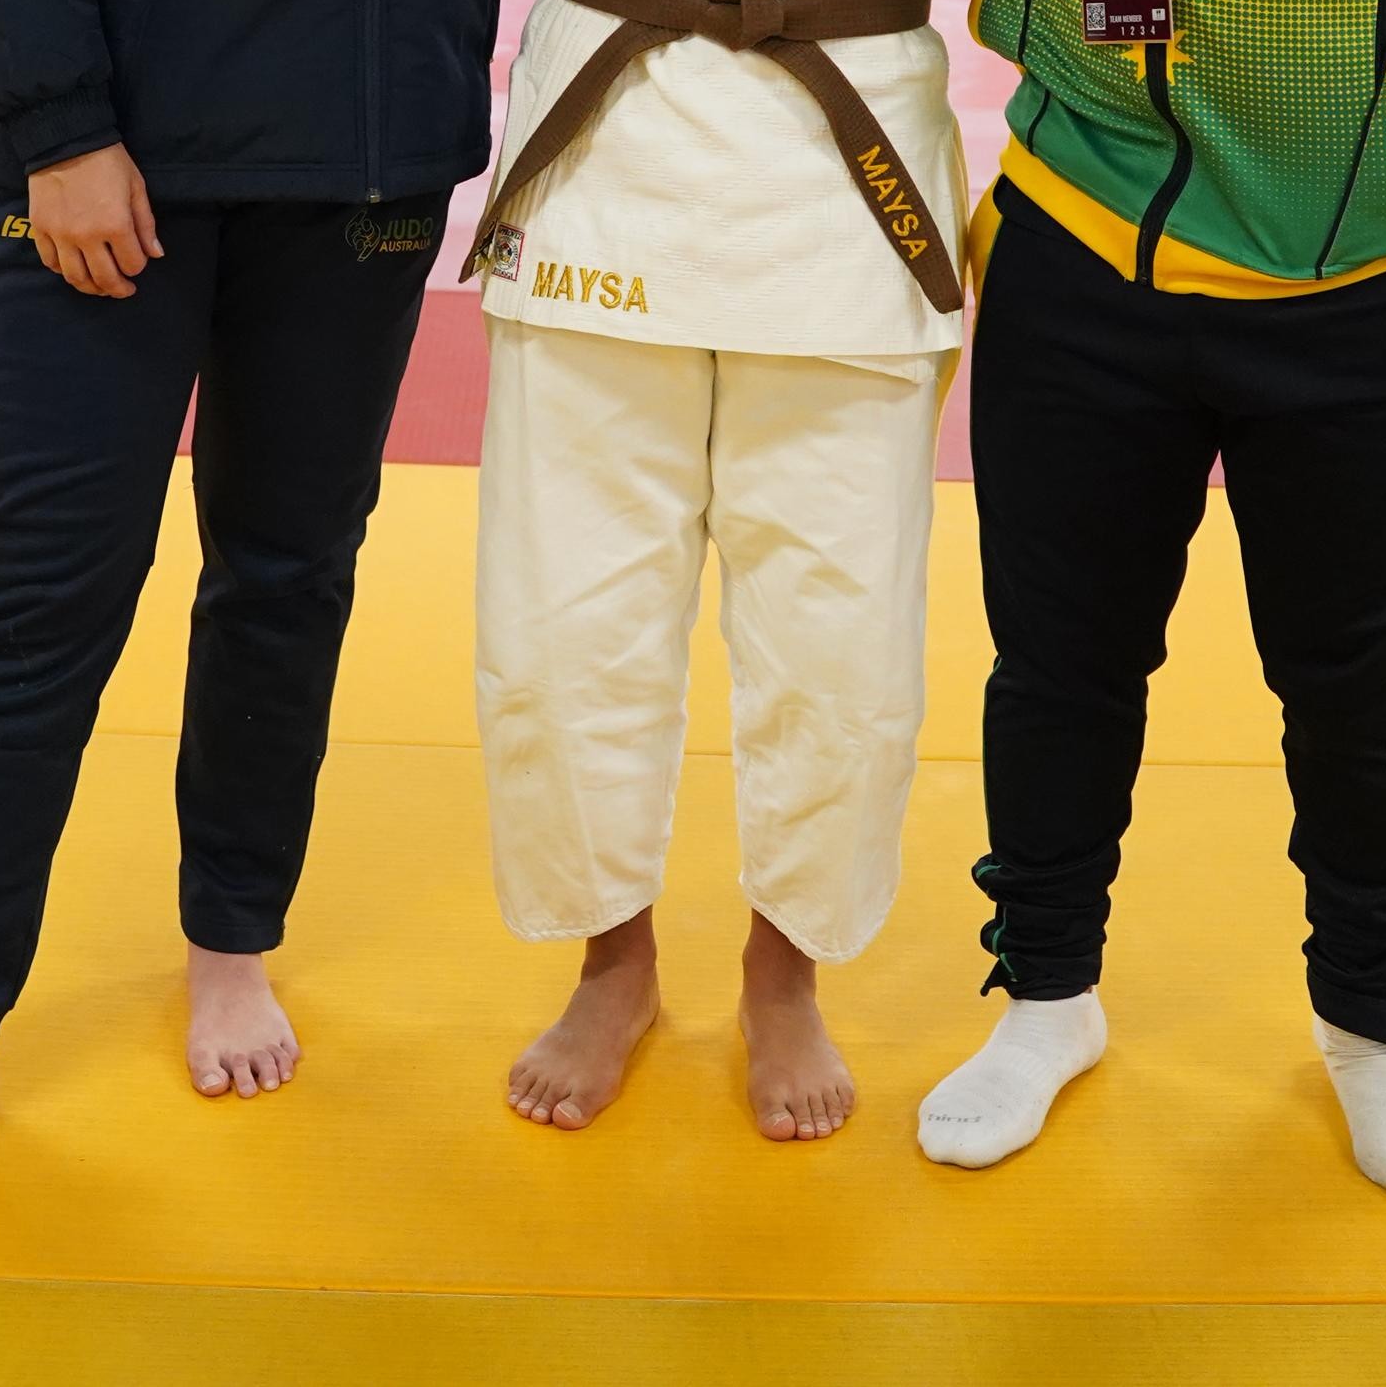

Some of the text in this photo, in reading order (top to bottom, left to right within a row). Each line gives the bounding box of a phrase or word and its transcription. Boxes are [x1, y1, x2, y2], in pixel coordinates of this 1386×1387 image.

[1121, 25, 1155, 36] 1 2 3 4
[857, 145, 928, 260] MAYSA
[381, 217, 433, 240] JUDO
[531, 261, 649, 314] MAYSA
